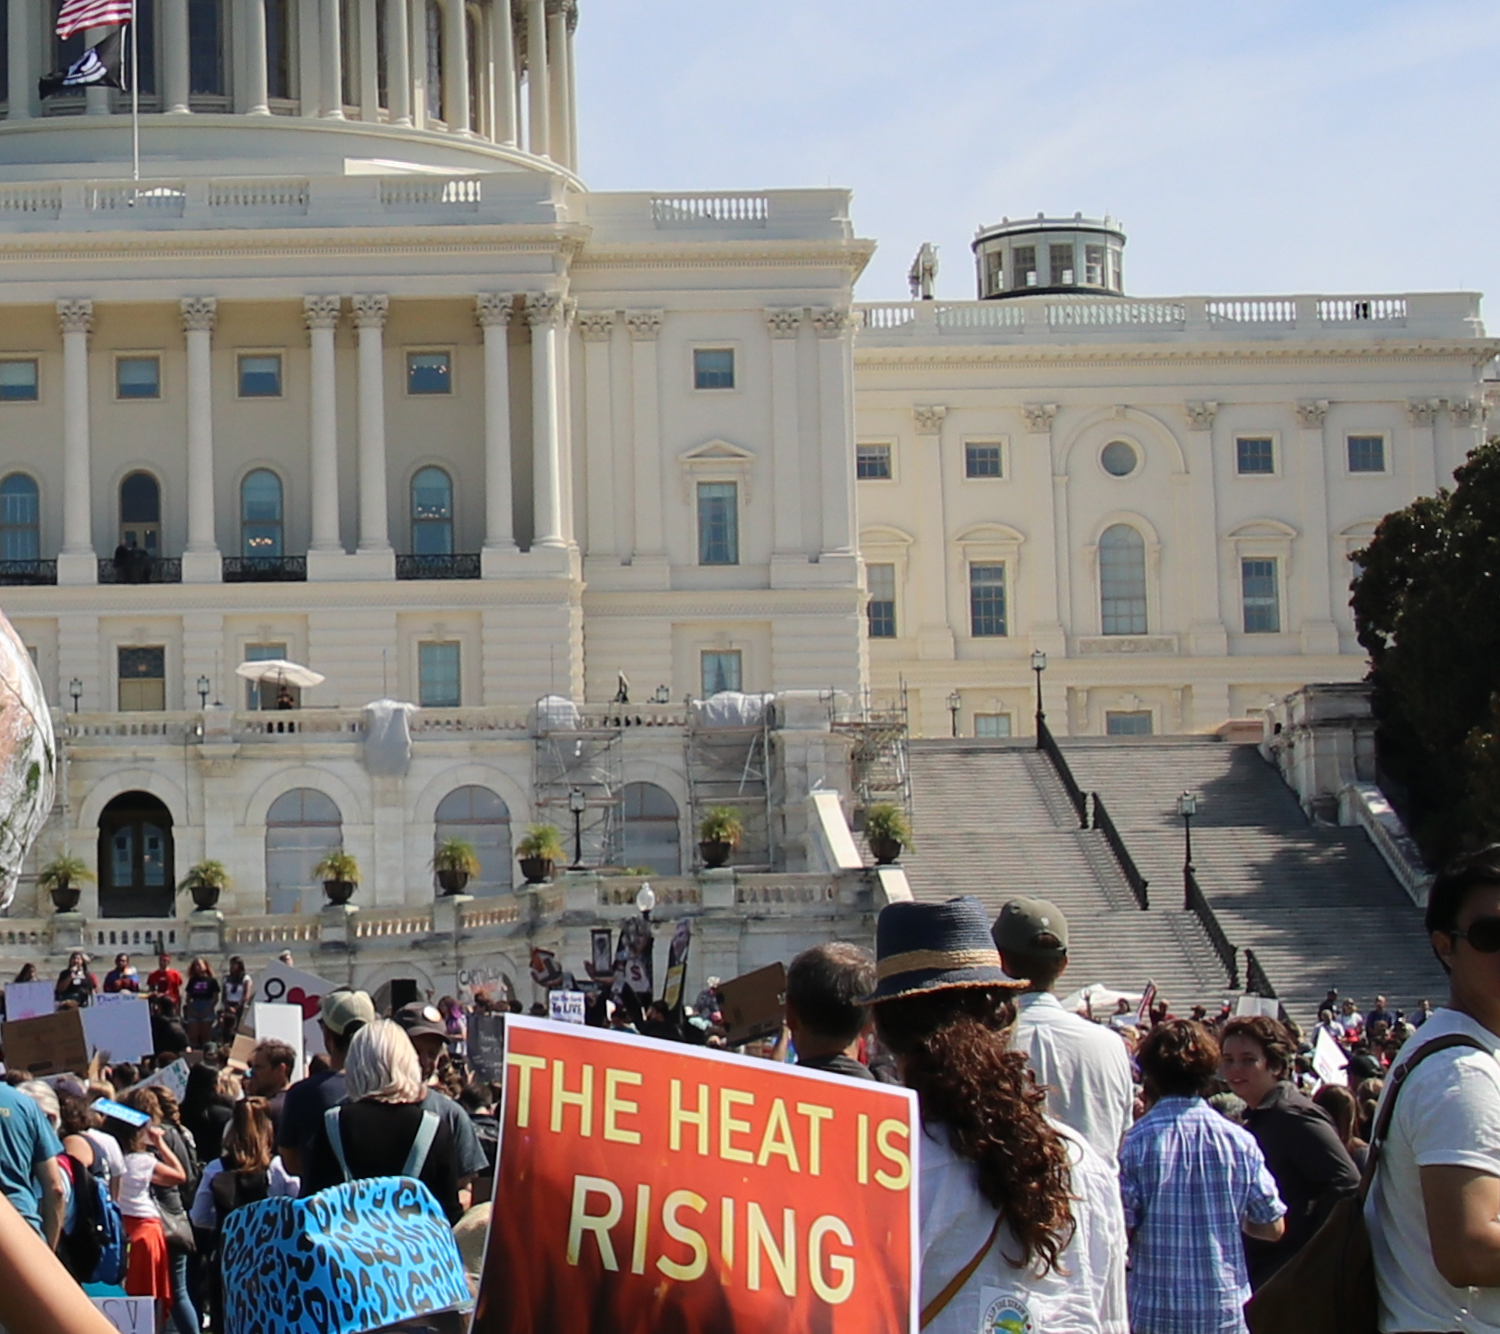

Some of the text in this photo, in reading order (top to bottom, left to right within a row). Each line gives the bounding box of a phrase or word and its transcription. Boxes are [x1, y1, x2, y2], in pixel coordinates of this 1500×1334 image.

[506, 1053, 642, 1144] THE
[669, 1079, 833, 1177] HEAT
[857, 1113, 911, 1191] IS
[567, 1174, 855, 1303] RISING
